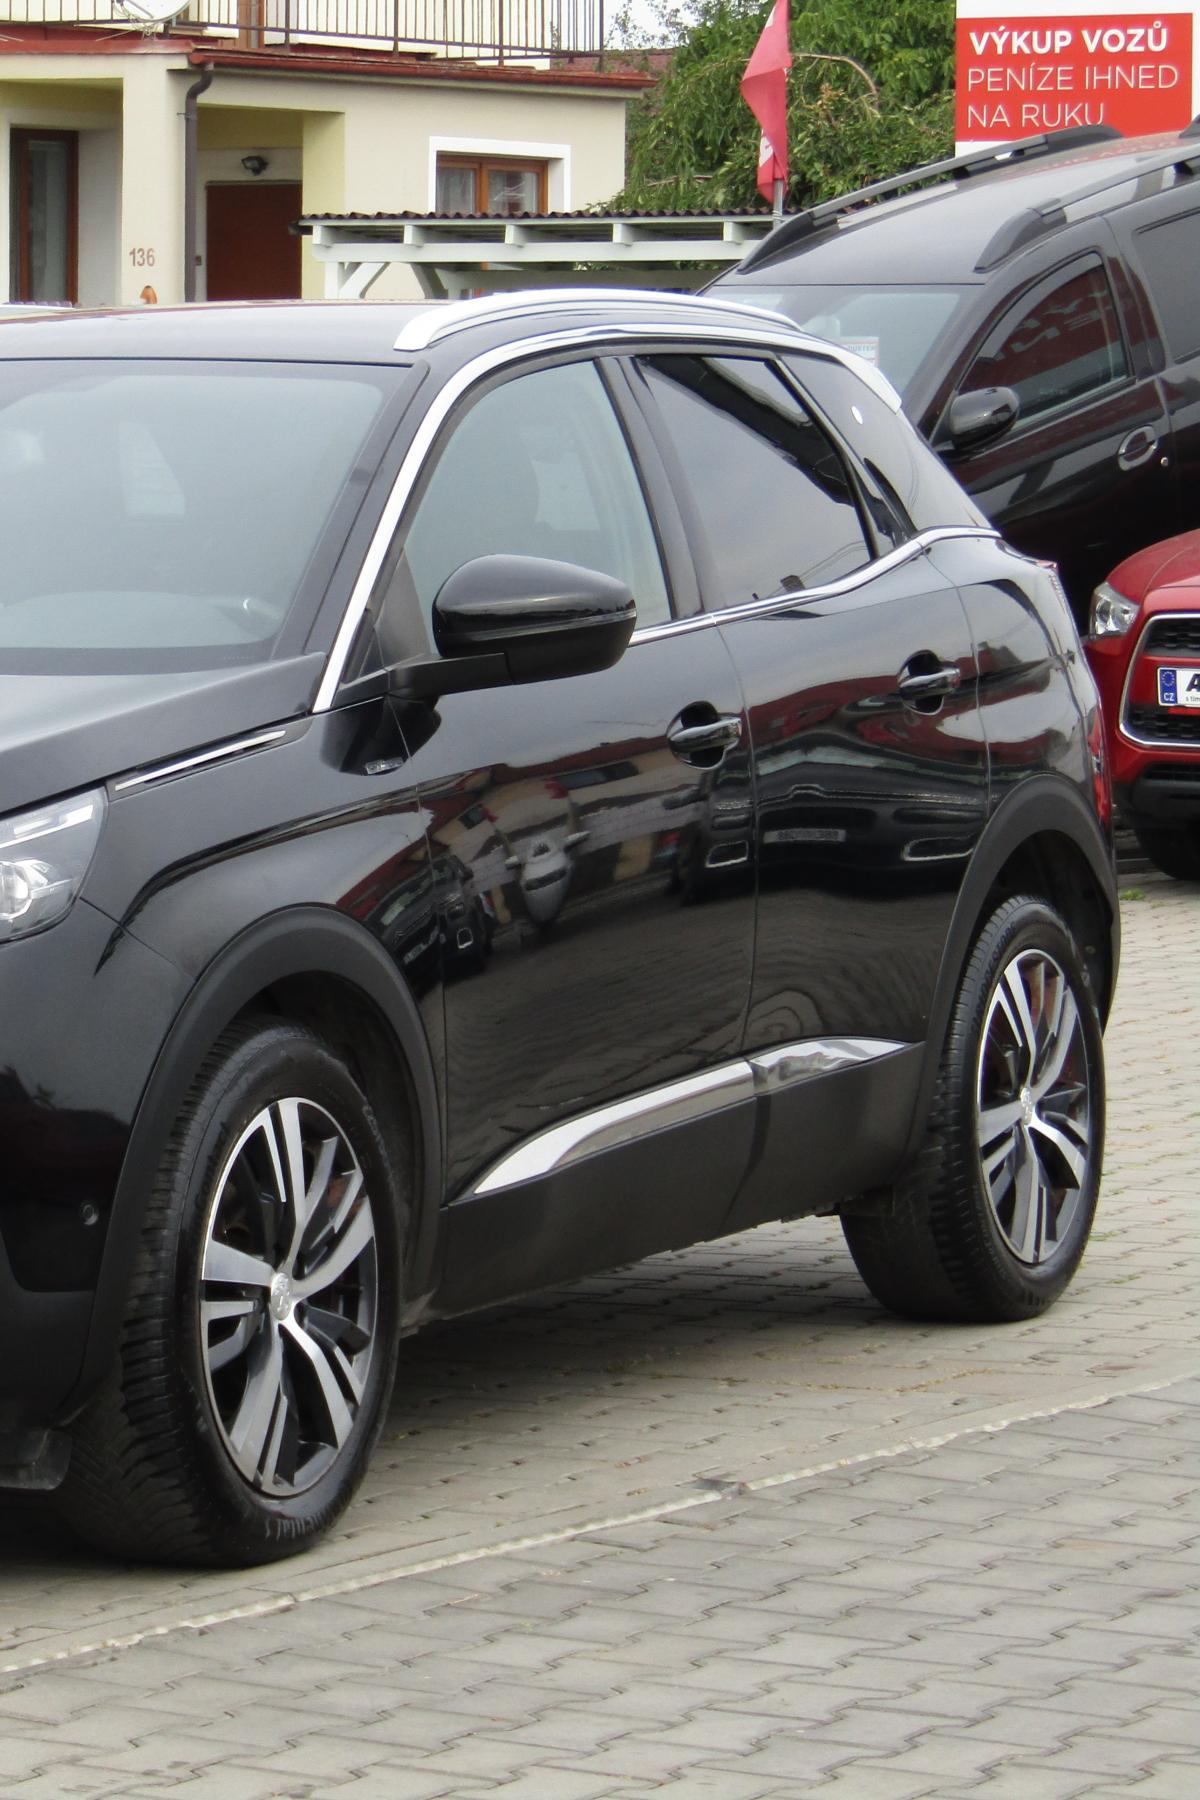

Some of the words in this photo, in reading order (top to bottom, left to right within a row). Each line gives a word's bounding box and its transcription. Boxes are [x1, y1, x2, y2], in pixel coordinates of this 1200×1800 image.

[969, 26, 1072, 55] VÝKUP
[1081, 20, 1167, 54] VOZŮ
[968, 62, 1074, 92] PENÍZE
[1085, 64, 1178, 90] IHNED
[968, 104, 1011, 128] NA
[1021, 103, 1104, 128] RUKU
[129, 248, 156, 267] 136
[1163, 692, 1175, 702] CZ
